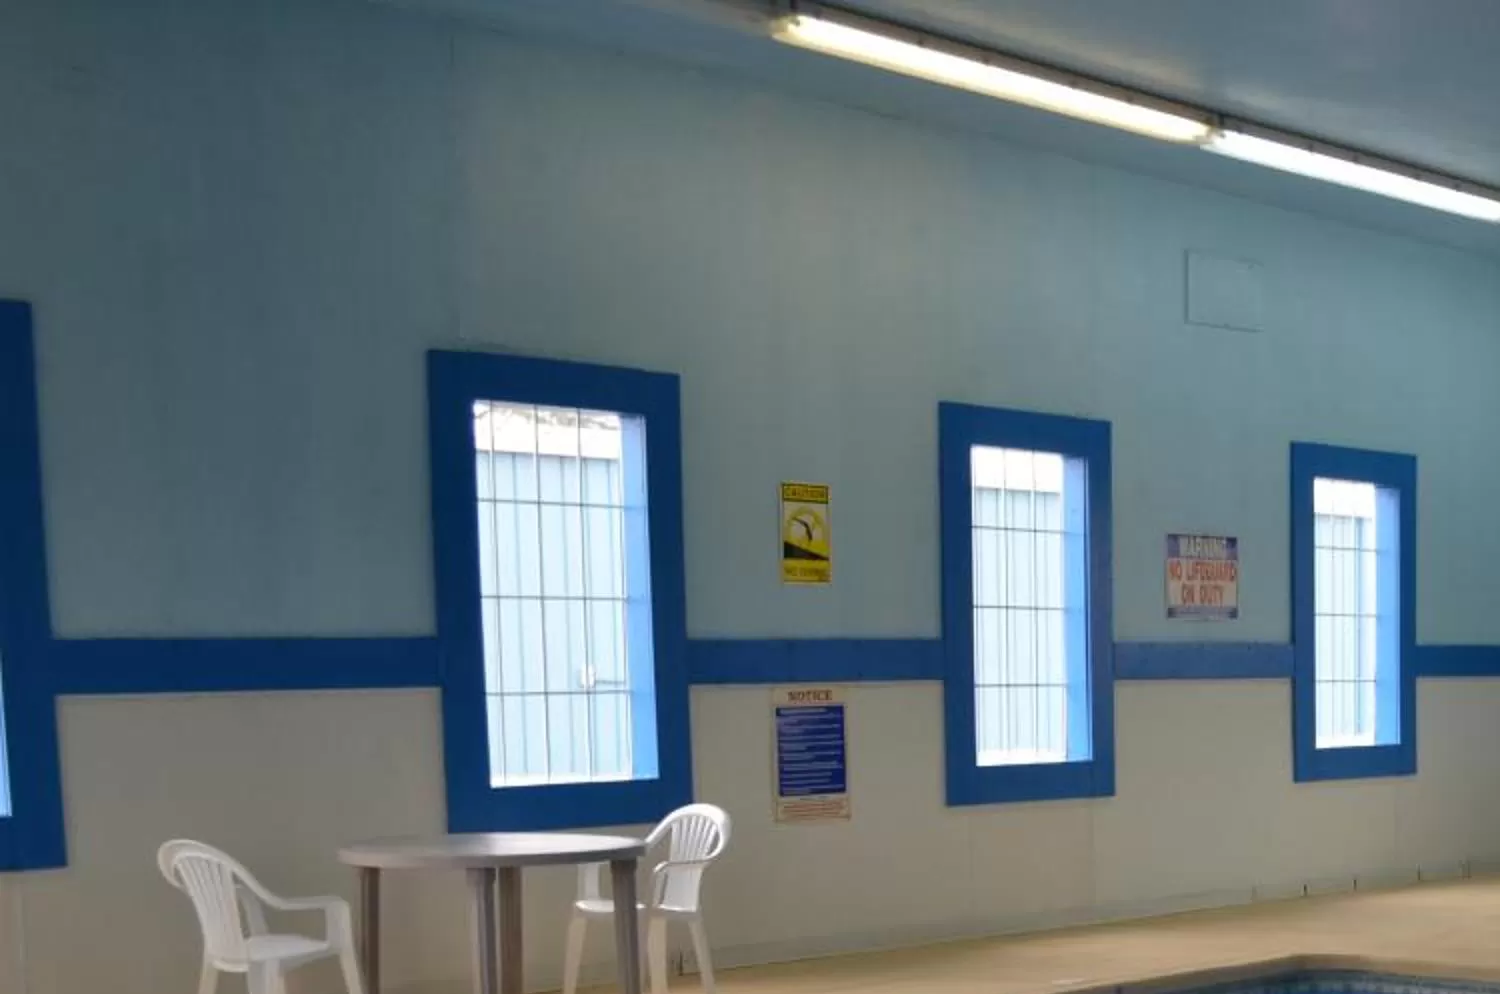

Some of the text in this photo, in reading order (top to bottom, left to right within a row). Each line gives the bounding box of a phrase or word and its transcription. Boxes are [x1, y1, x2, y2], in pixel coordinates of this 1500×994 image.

[784, 487, 825, 499] CAUTION
[1179, 536, 1226, 558] WARNING
[1169, 561, 1237, 582] NO LIFEGUARD
[1182, 584, 1224, 605] ON DUTY
[788, 689, 833, 701] NOTICE
